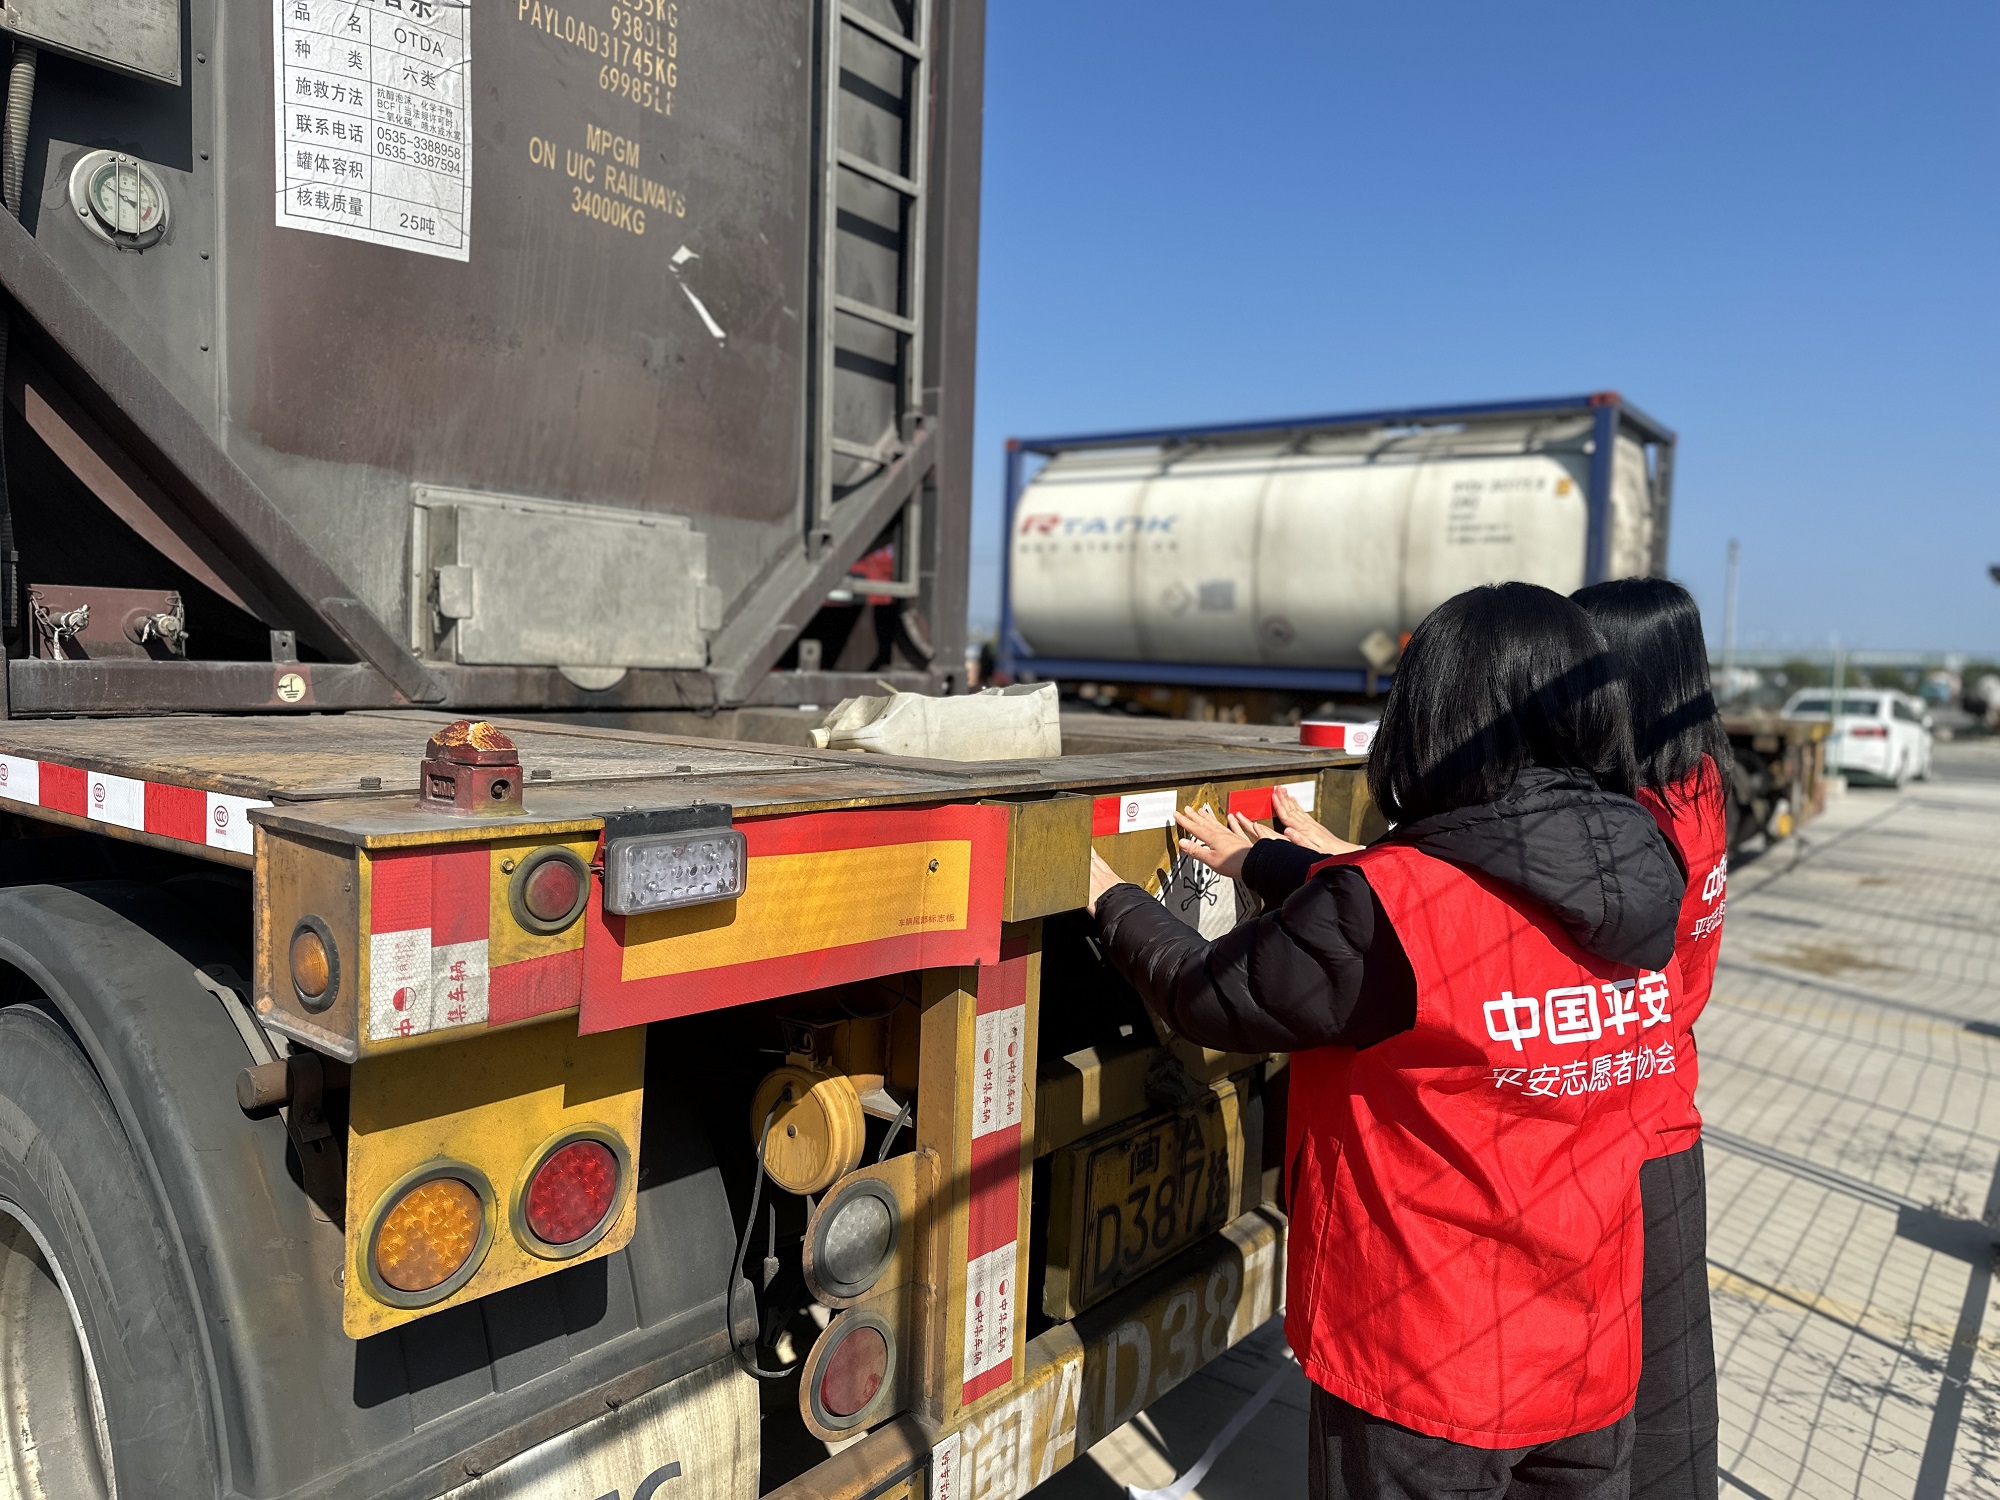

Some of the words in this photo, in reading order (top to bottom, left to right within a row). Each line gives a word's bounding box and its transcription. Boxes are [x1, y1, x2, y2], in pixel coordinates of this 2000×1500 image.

[394, 27, 444, 58] OTDA
[295, 76, 364, 107] 施救方法
[403, 65, 436, 91] 六类
[296, 114, 364, 144] 联系电话
[377, 126, 461, 160] 0535-3388958
[377, 141, 461, 175] 0535-3387594
[586, 123, 640, 169] MPGM
[296, 150, 364, 180] 罐体容积
[529, 136, 556, 170] ON
[566, 149, 596, 183] UIC
[604, 164, 687, 218] RAILWAYS
[296, 187, 364, 217] 核载质量
[571, 186, 645, 235] 34000KG
[399, 212, 436, 236] 25吨
[1482, 970, 1672, 1052] 中国平安
[1484, 1039, 1676, 1098] 平安志愿者协会
